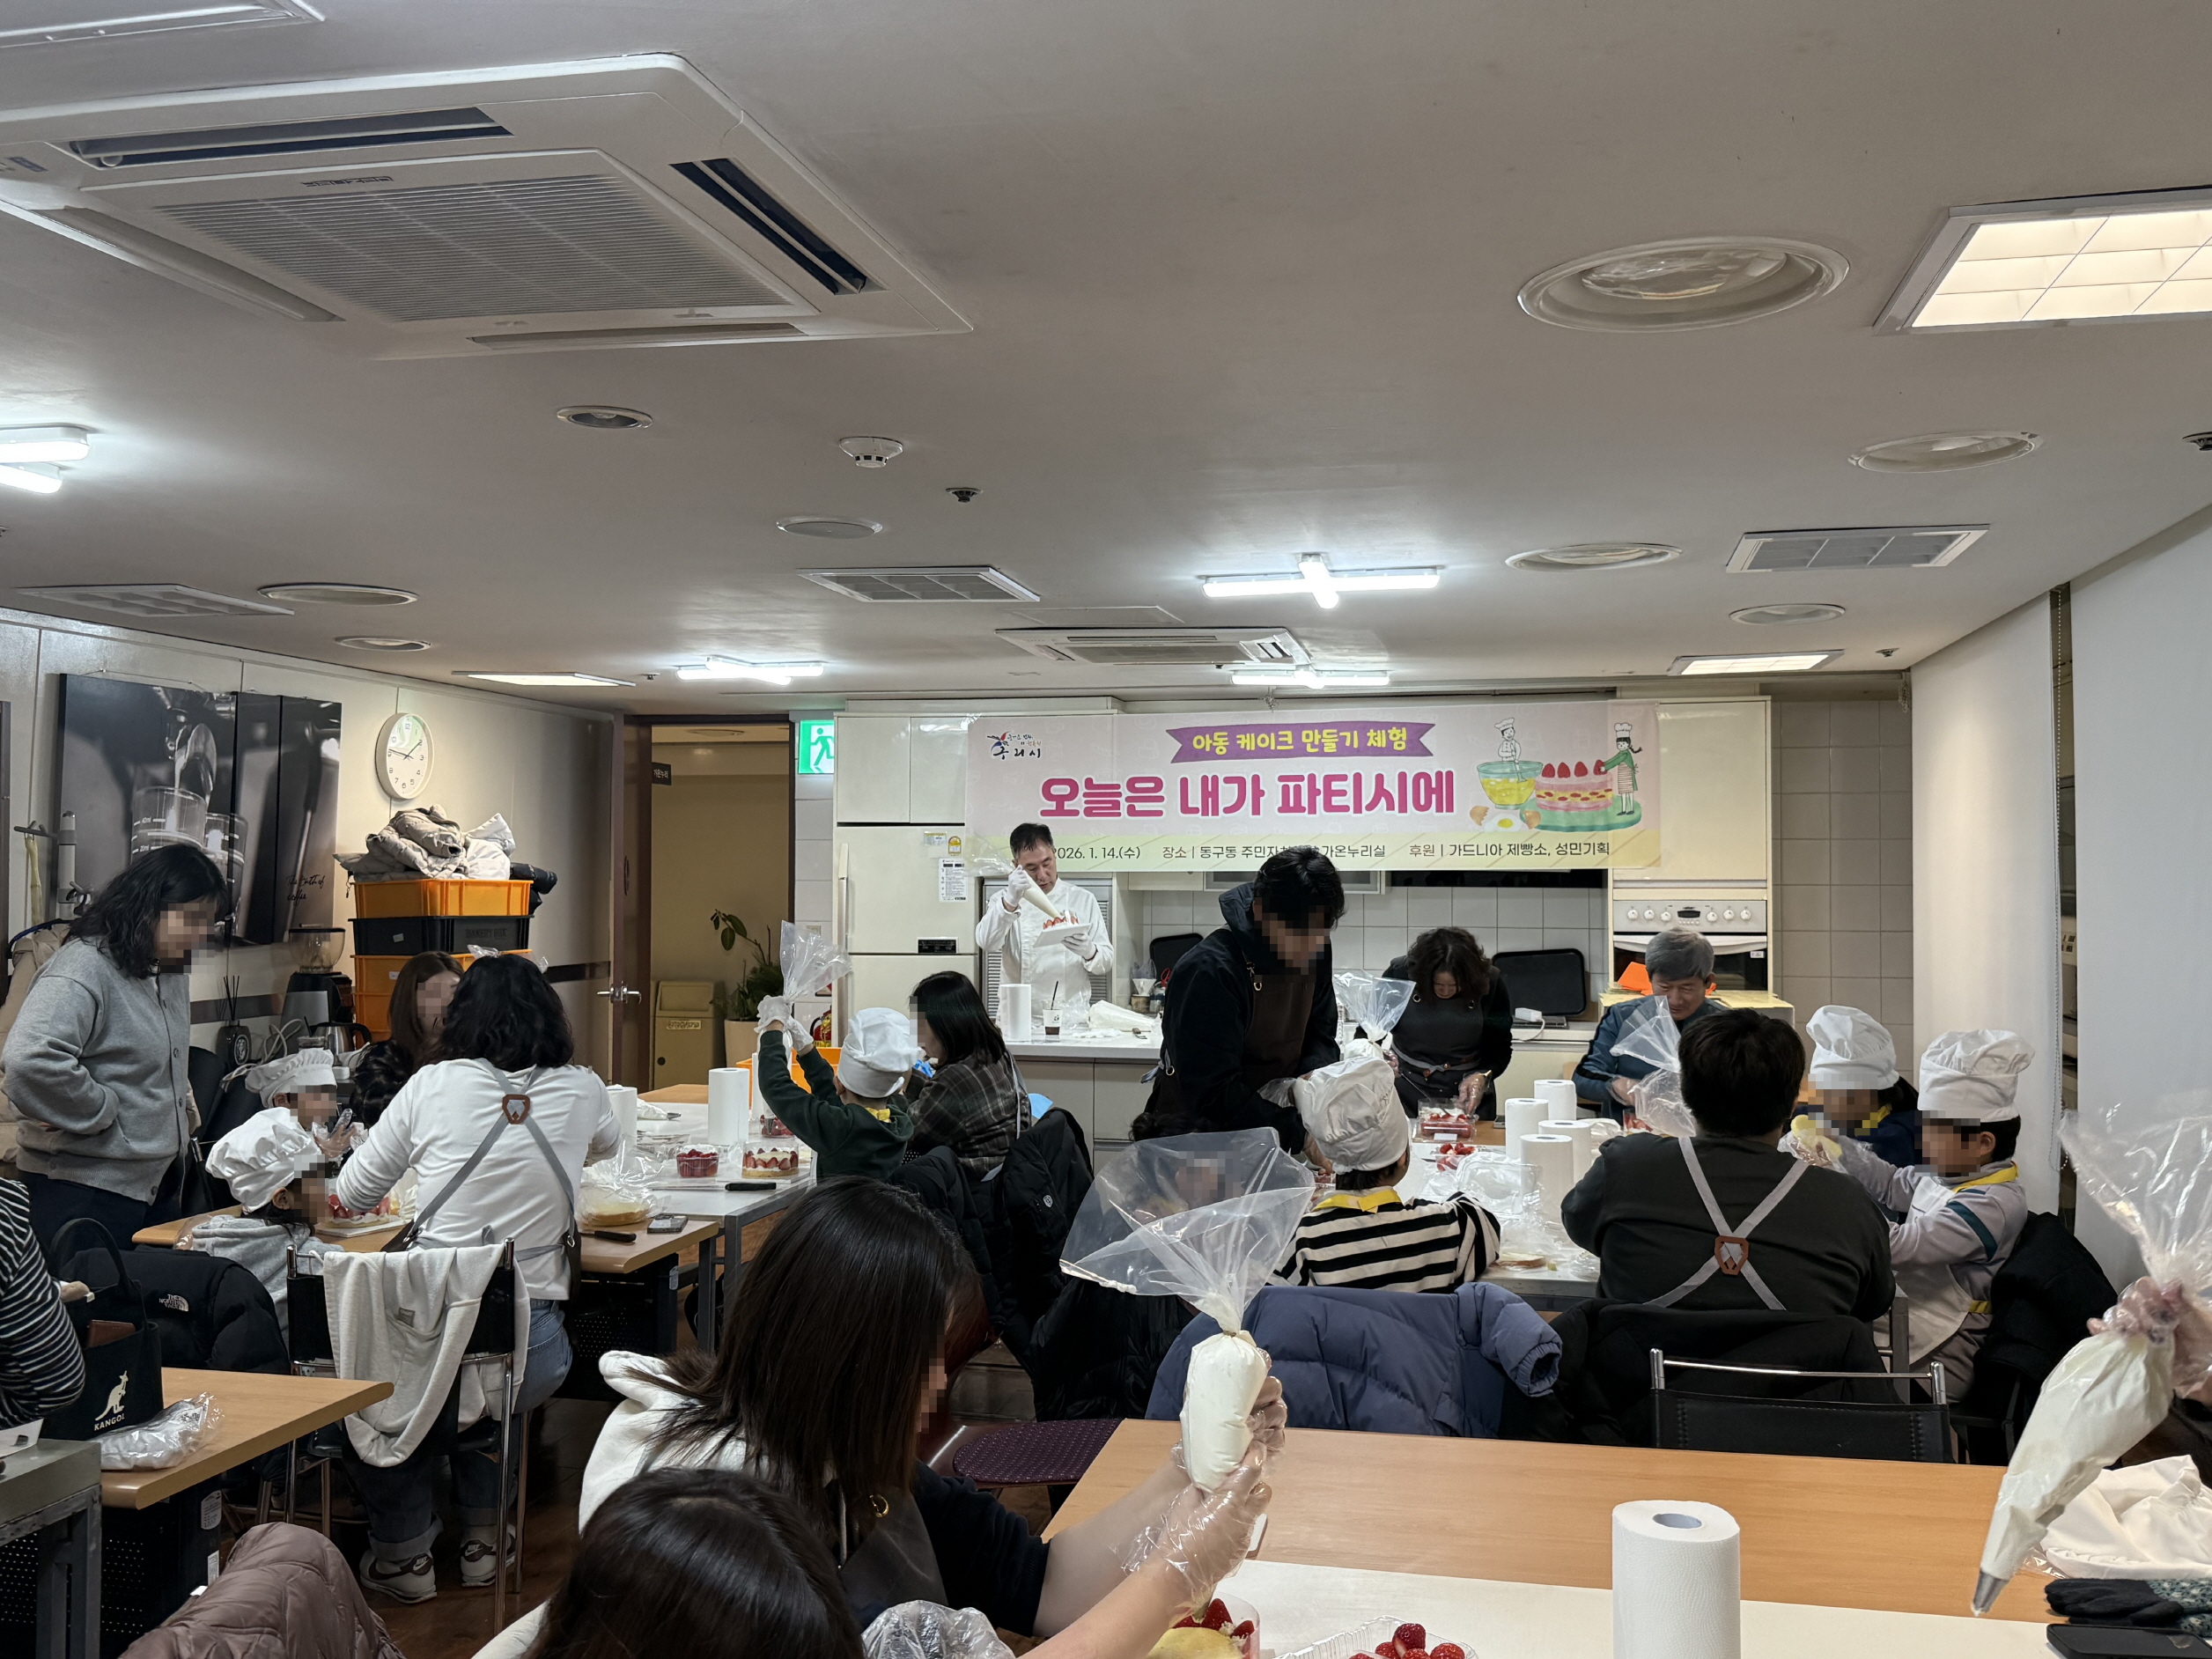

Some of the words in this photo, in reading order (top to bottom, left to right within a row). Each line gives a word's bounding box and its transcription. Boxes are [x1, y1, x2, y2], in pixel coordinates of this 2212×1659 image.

[1192, 730, 1229, 755] 아동
[1235, 730, 1294, 751] 케이크
[1301, 728, 1359, 753] 만들기
[1366, 726, 1407, 751] 체험
[992, 746, 1041, 760] 구리시
[1039, 775, 1165, 817] 오늘은
[1179, 773, 1265, 817] 내가
[1276, 770, 1455, 815] 파티시에
[1089, 847, 1098, 859] 1.
[1102, 845, 1141, 859] 14.(수)
[1161, 845, 1187, 859] 장소
[1199, 845, 1237, 859] 동구동
[1324, 844, 1385, 858] 가온누리실
[1408, 844, 1435, 858] 후원
[1449, 843, 1503, 857] 가드니아
[1506, 843, 1551, 857] 제빵소,
[1554, 842, 1610, 856] 성민기획
